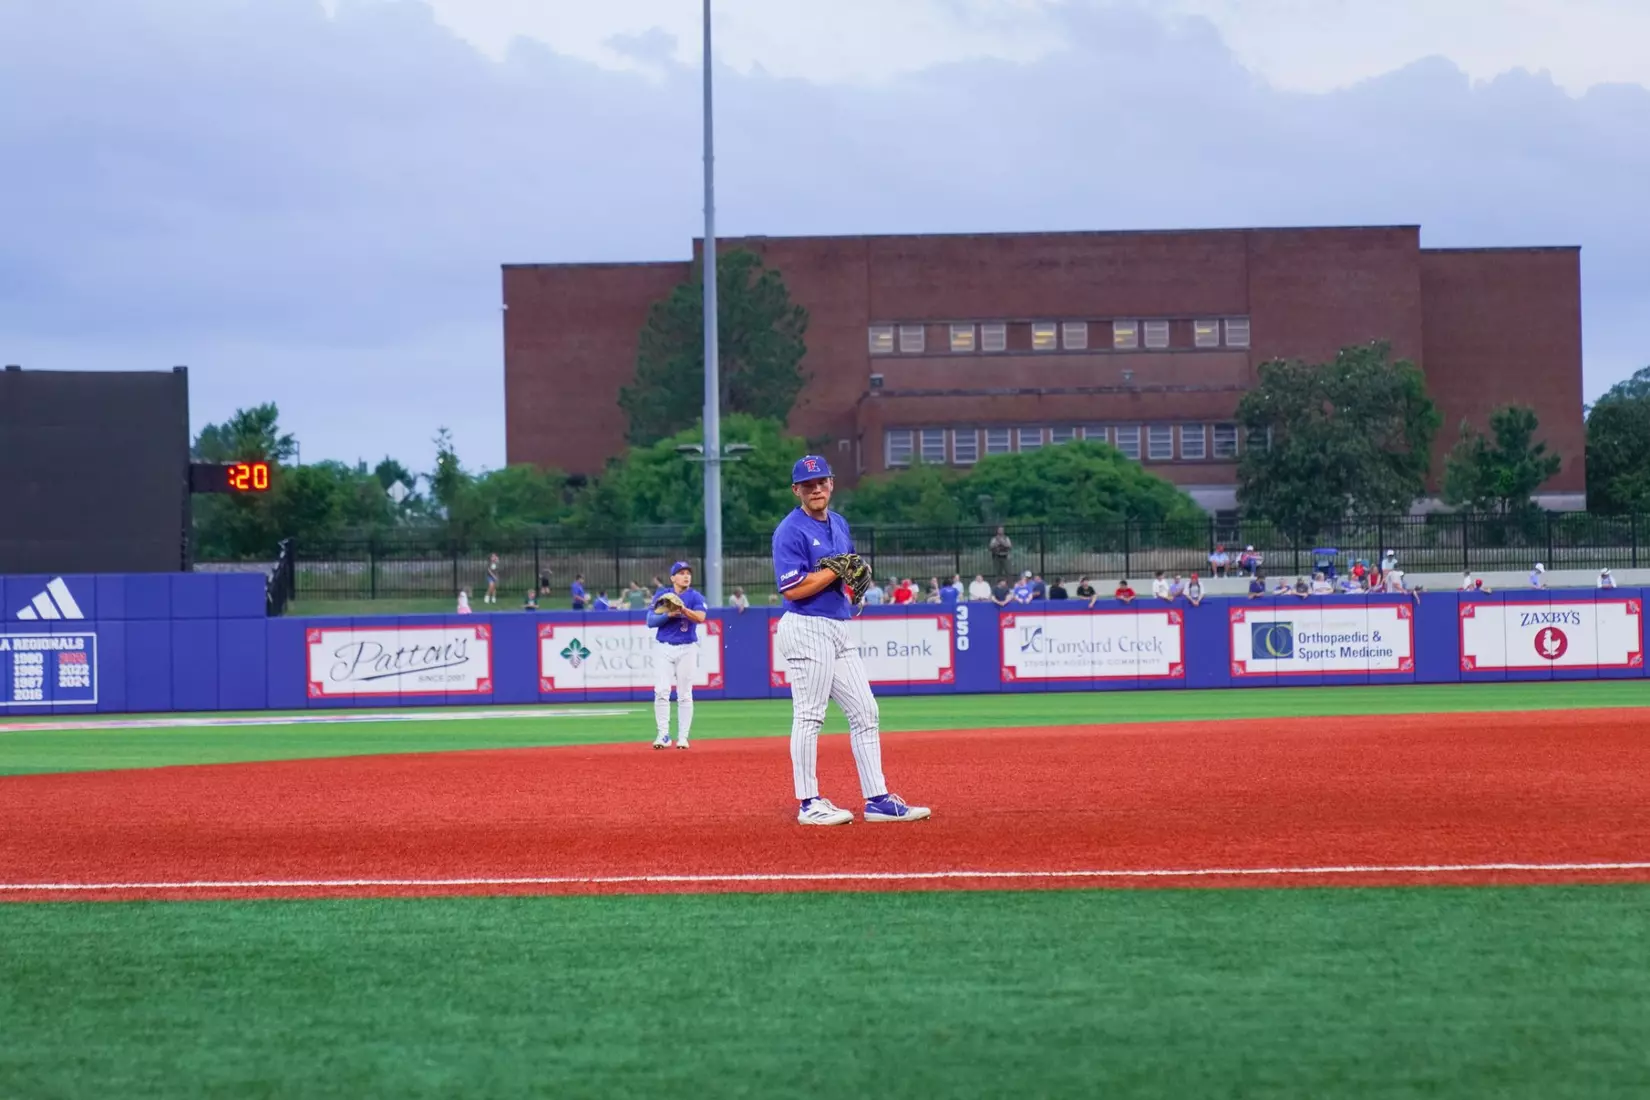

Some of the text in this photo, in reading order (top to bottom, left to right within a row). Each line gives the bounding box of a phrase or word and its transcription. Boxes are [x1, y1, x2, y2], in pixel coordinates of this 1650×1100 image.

[1520, 610, 1581, 627] ZAXBY'S
[956, 605, 969, 651] 350
[13, 637, 84, 650] REGIONALS
[1045, 636, 1163, 657] Tanyard Creek
[1298, 630, 1382, 646] Orthopaedic &
[886, 639, 932, 657] Bank
[1298, 646, 1393, 662] Sports Medicine
[330, 638, 467, 682] Patton's
